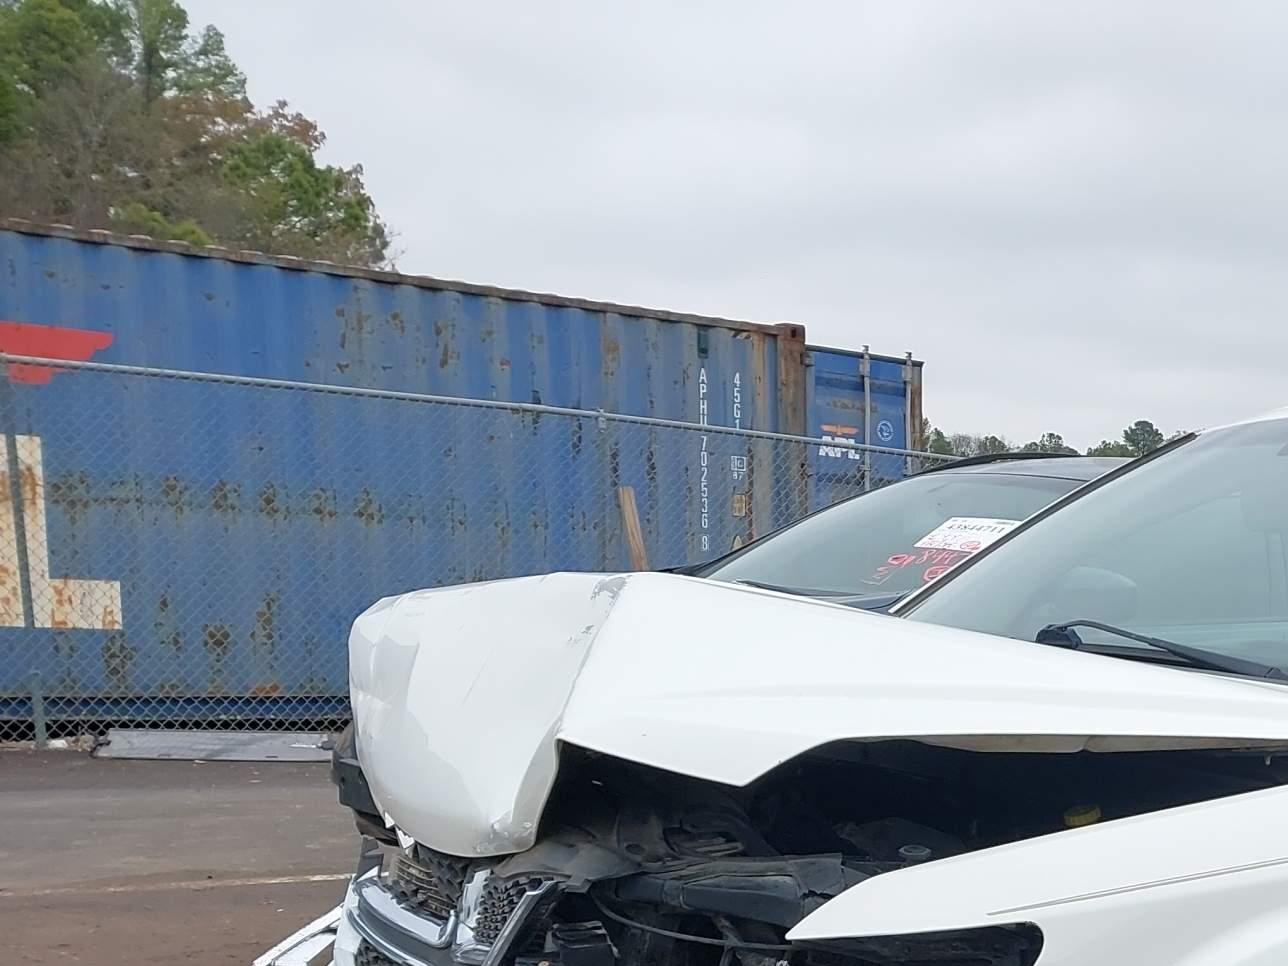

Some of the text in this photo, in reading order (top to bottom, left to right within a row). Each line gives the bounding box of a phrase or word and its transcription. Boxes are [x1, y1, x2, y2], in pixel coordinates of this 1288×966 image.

[733, 371, 741, 430] 45G1
[701, 435, 709, 528] 702536
[702, 535, 709, 551] 8
